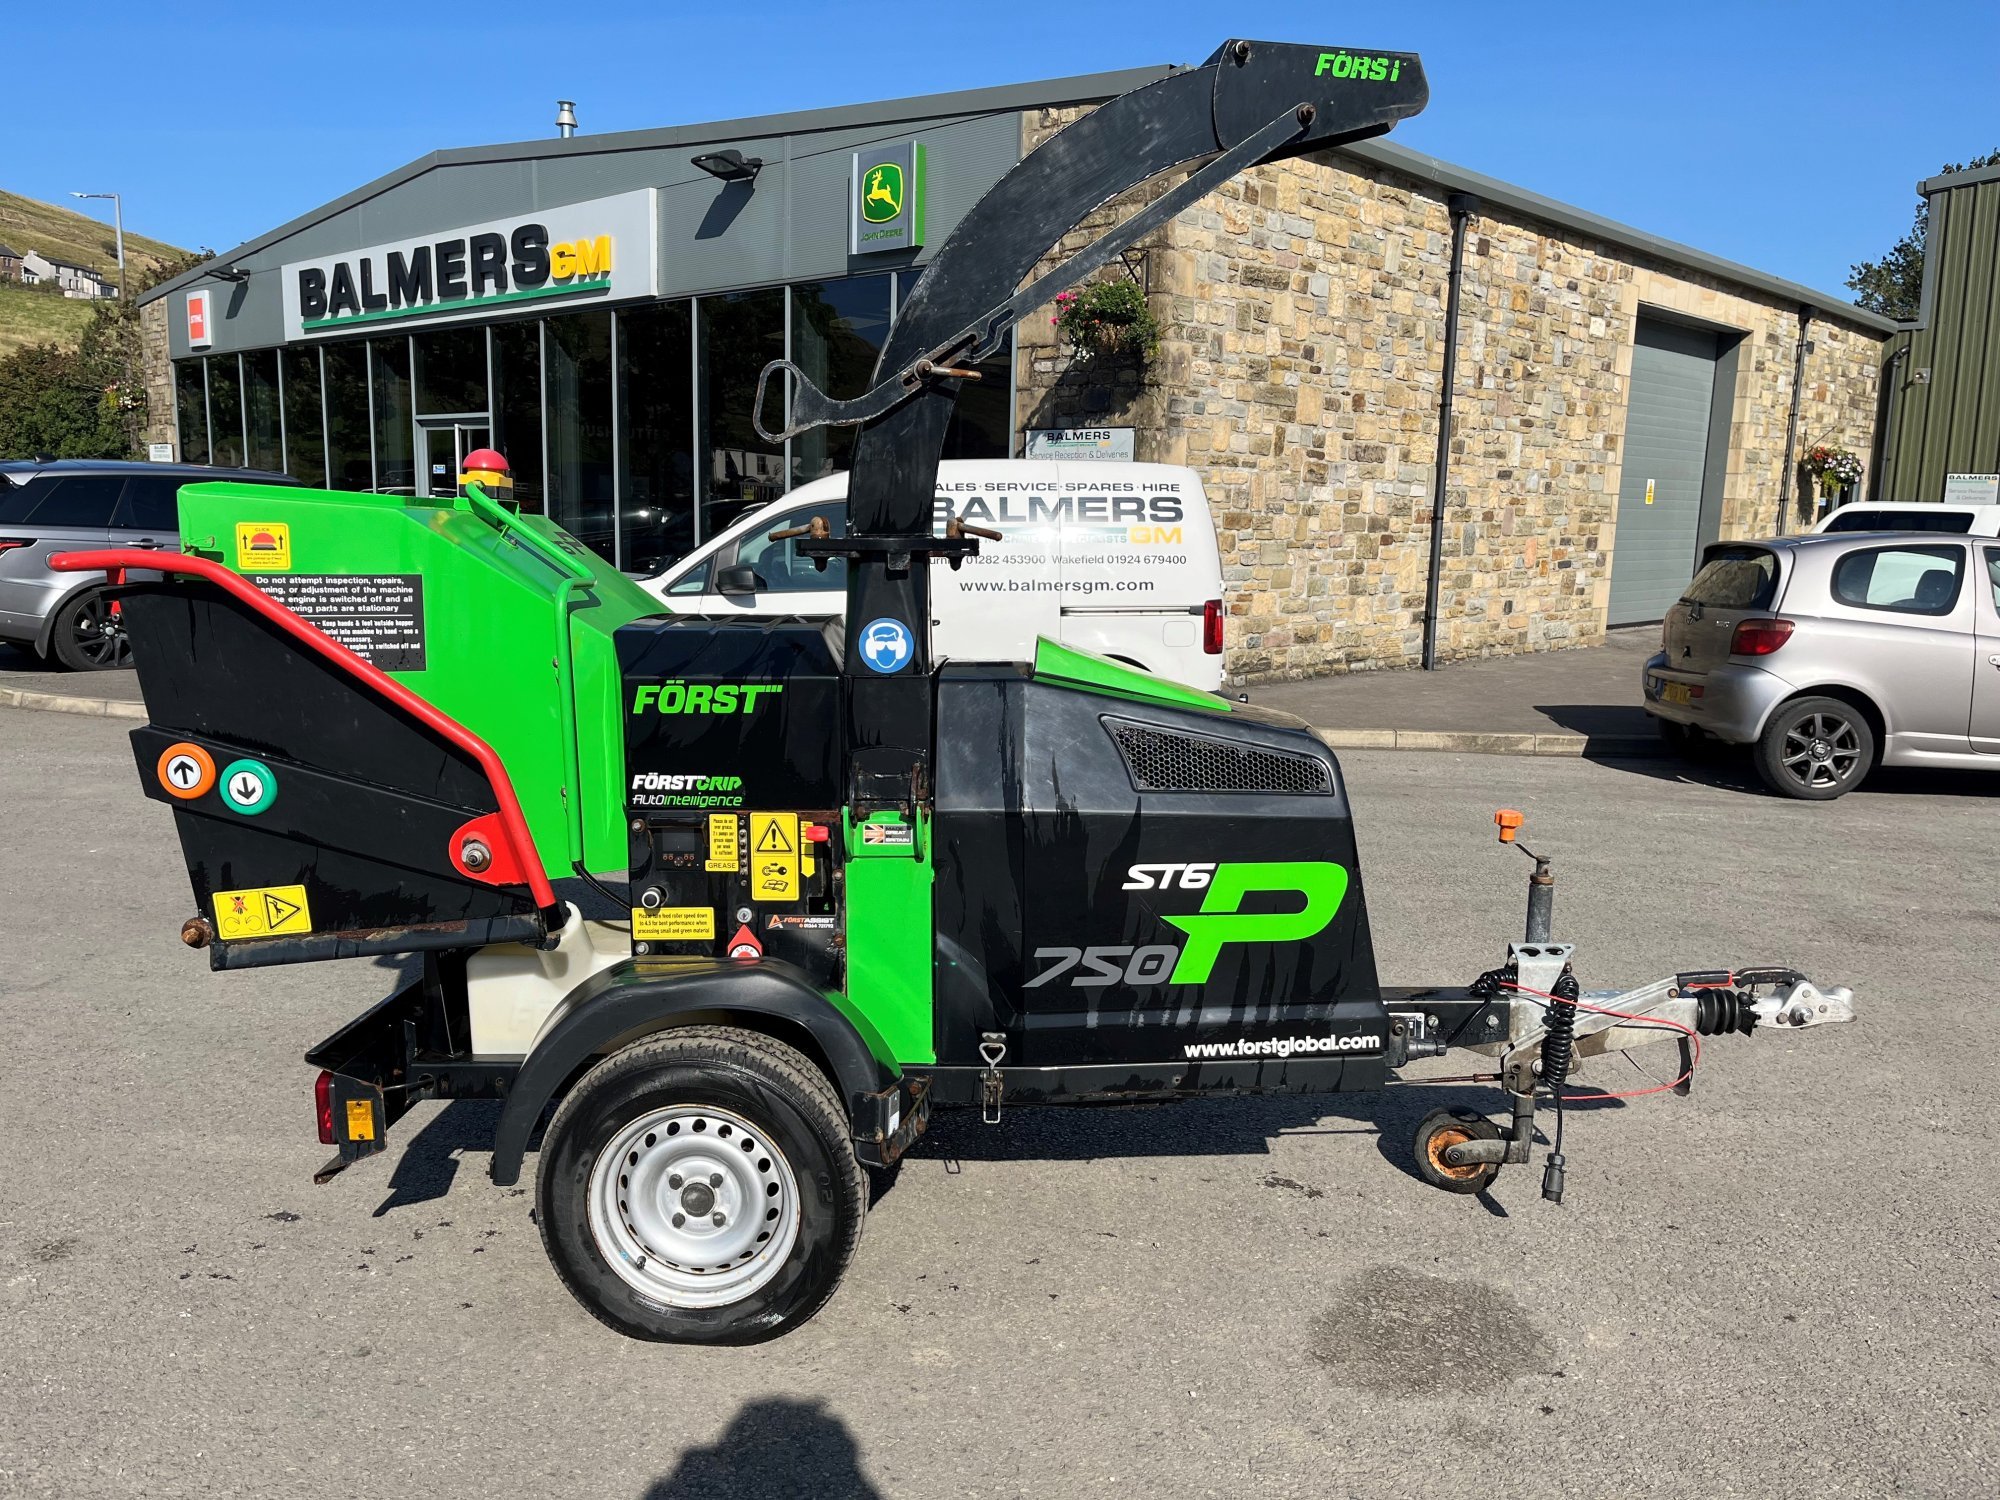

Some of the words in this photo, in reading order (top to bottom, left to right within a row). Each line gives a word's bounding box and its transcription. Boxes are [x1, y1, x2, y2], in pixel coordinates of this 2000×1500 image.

[879, 228, 904, 239] DEERE
[299, 224, 549, 317] BALMERS
[551, 235, 612, 279] GM
[1047, 431, 1110, 440] BALMERS
[1030, 451, 1053, 459] Service
[1055, 451, 1087, 459] Reception
[1089, 451, 1094, 459] &
[1096, 451, 1128, 459] Deliveries
[935, 482, 976, 491] ALES
[985, 482, 1057, 491] SERVICE
[1062, 482, 1136, 491] SPARES
[1142, 482, 1181, 491] HIRE
[933, 496, 1184, 522] BALMERS
[1130, 526, 1182, 544] GM
[965, 555, 1000, 565] 01282
[1002, 555, 1046, 565] 453900
[1051, 555, 1104, 565] Wakefield
[1106, 555, 1141, 565] 01924
[1143, 555, 1187, 565] 679400
[289, 577, 322, 586] attempt
[326, 577, 371, 586] inspection,
[374, 577, 404, 586] repairs,
[959, 579, 1154, 594] www.balmersgm.com
[260, 586, 286, 595] aning,
[301, 586, 348, 595] adjustment
[288, 596, 316, 604] engine
[316, 605, 338, 613] parts
[341, 605, 354, 613] are
[358, 605, 399, 613] stationary
[633, 680, 783, 714] FÖRST
[1122, 863, 1216, 890] ST6
[1021, 945, 1179, 988] 750
[1184, 1035, 1381, 1057] www.forstglobal.com
